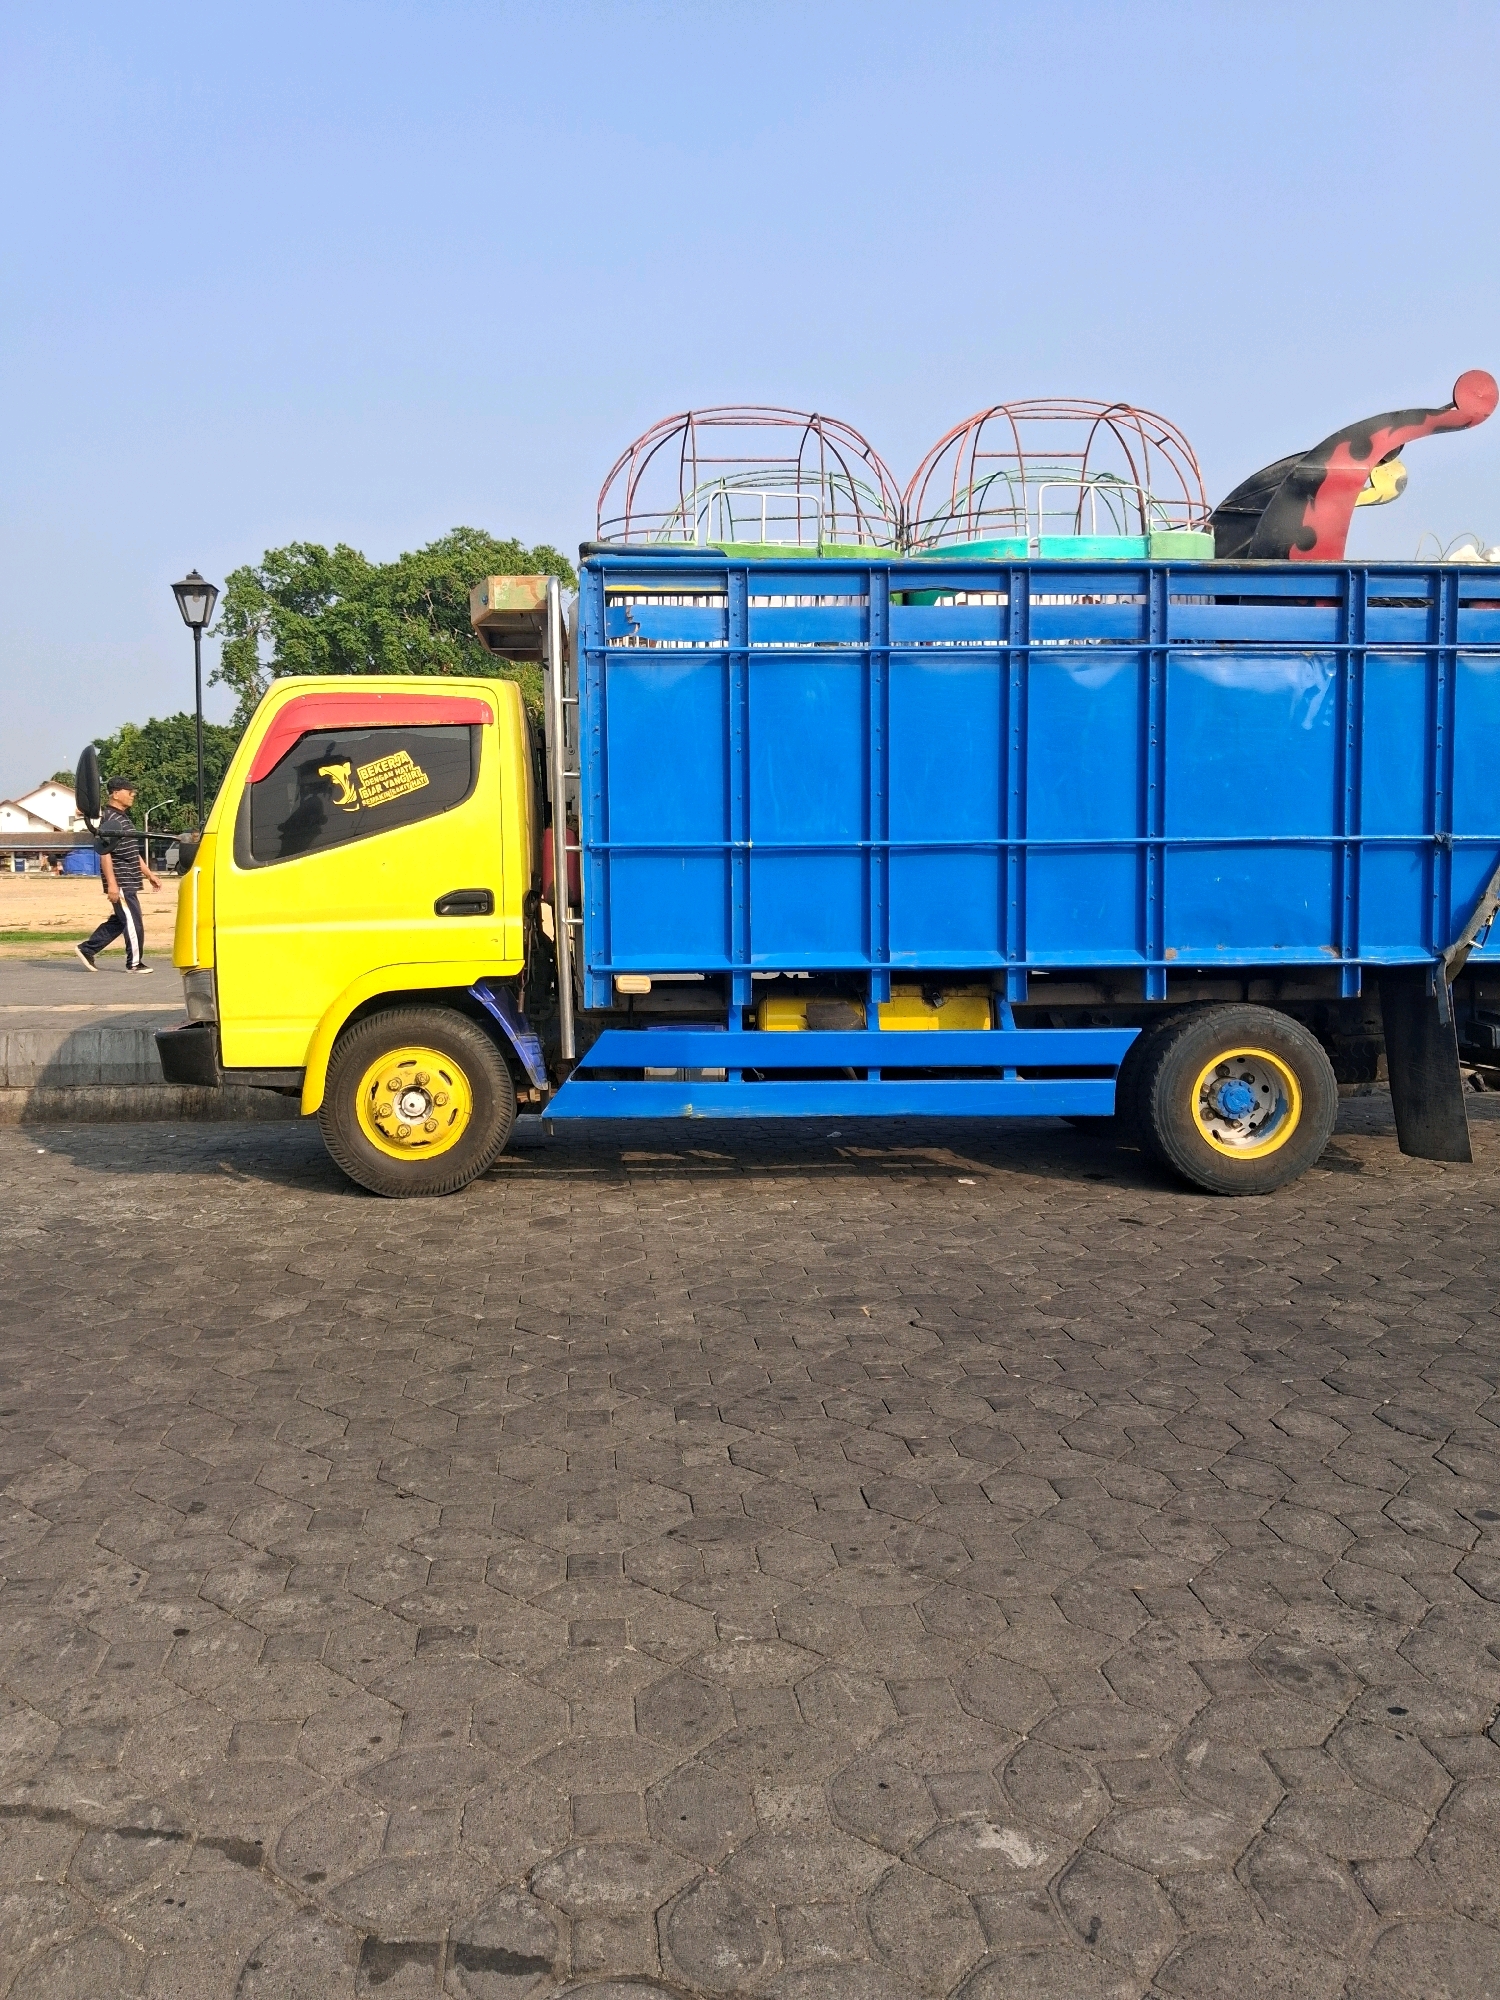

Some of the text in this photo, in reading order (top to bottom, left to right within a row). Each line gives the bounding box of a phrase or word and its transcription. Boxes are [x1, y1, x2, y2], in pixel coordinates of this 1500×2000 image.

[360, 752, 410, 780] BEKERJA
[365, 770, 394, 787] DENGAN
[361, 784, 383, 799] BIAR
[382, 773, 407, 789] YANG
